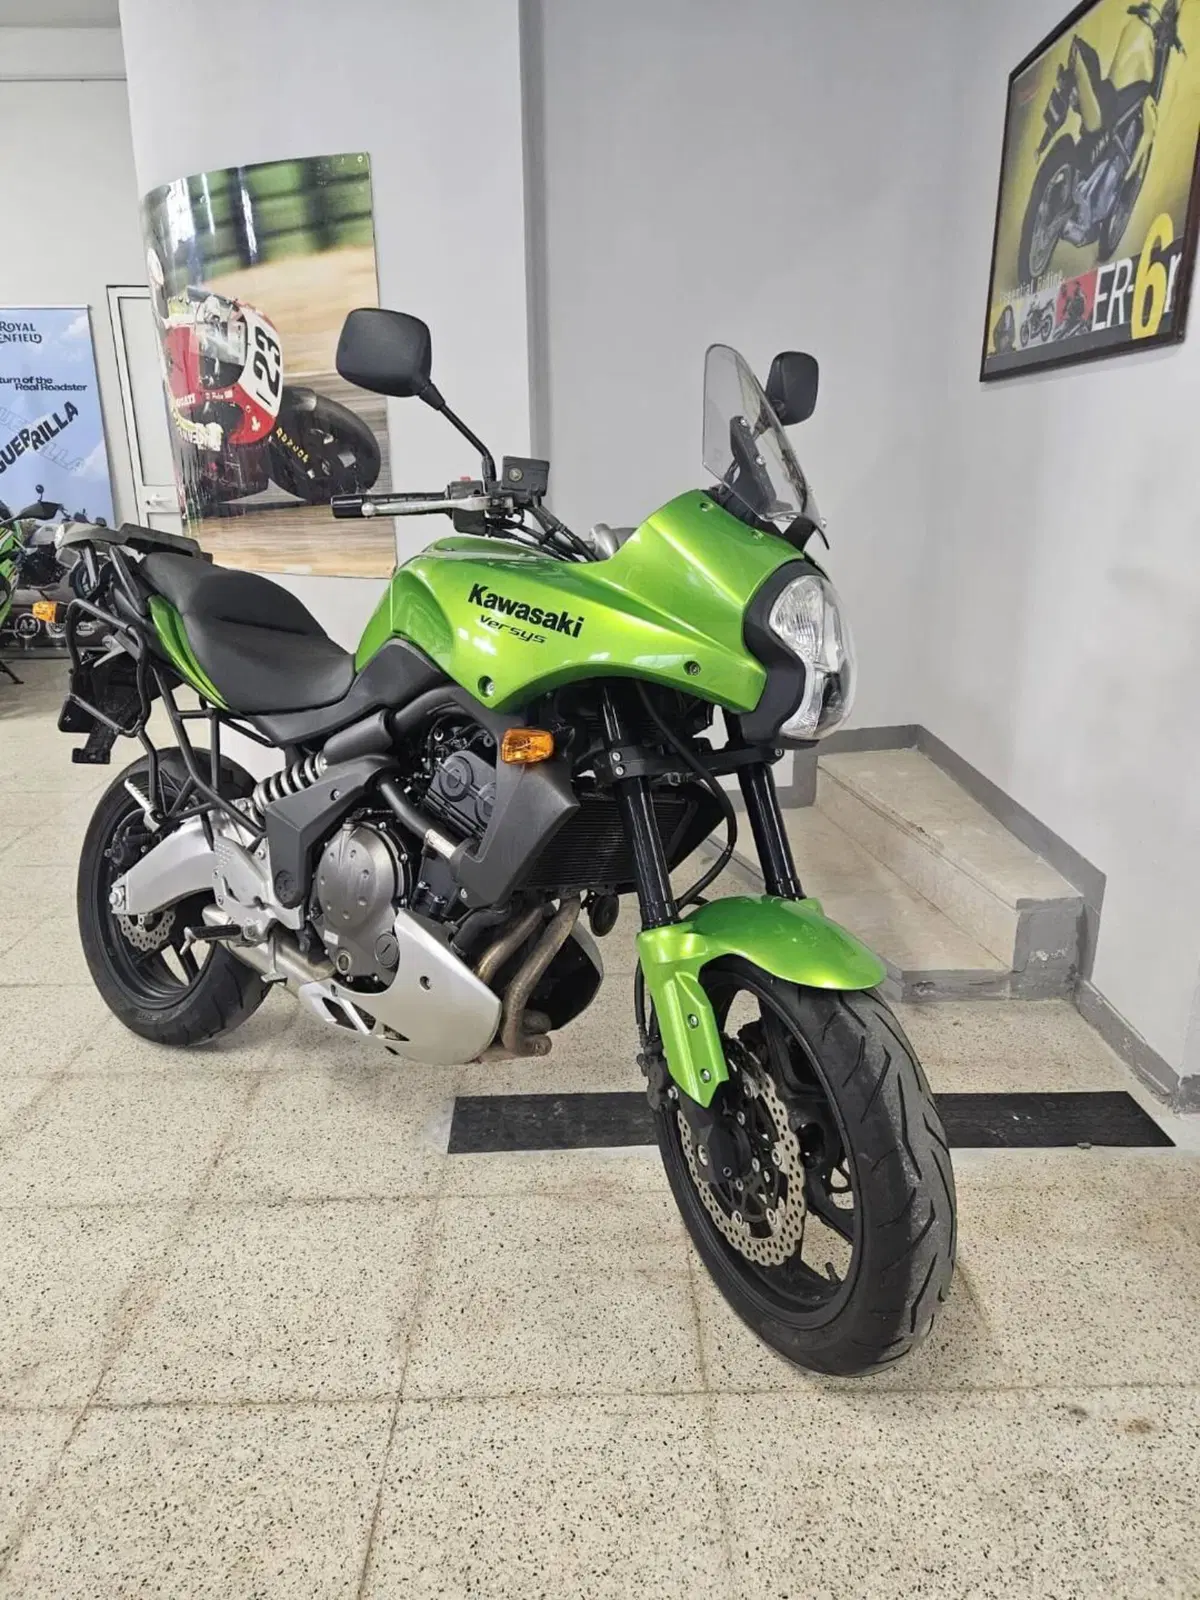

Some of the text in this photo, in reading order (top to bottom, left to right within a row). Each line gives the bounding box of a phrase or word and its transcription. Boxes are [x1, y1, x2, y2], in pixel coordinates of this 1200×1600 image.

[0, 321, 36, 333] ROYAL
[22, 376, 34, 384] of
[35, 376, 53, 384] the
[15, 383, 88, 391] Real Roadster
[468, 583, 585, 638] Kawasaki
[19, 619, 37, 632] A2
